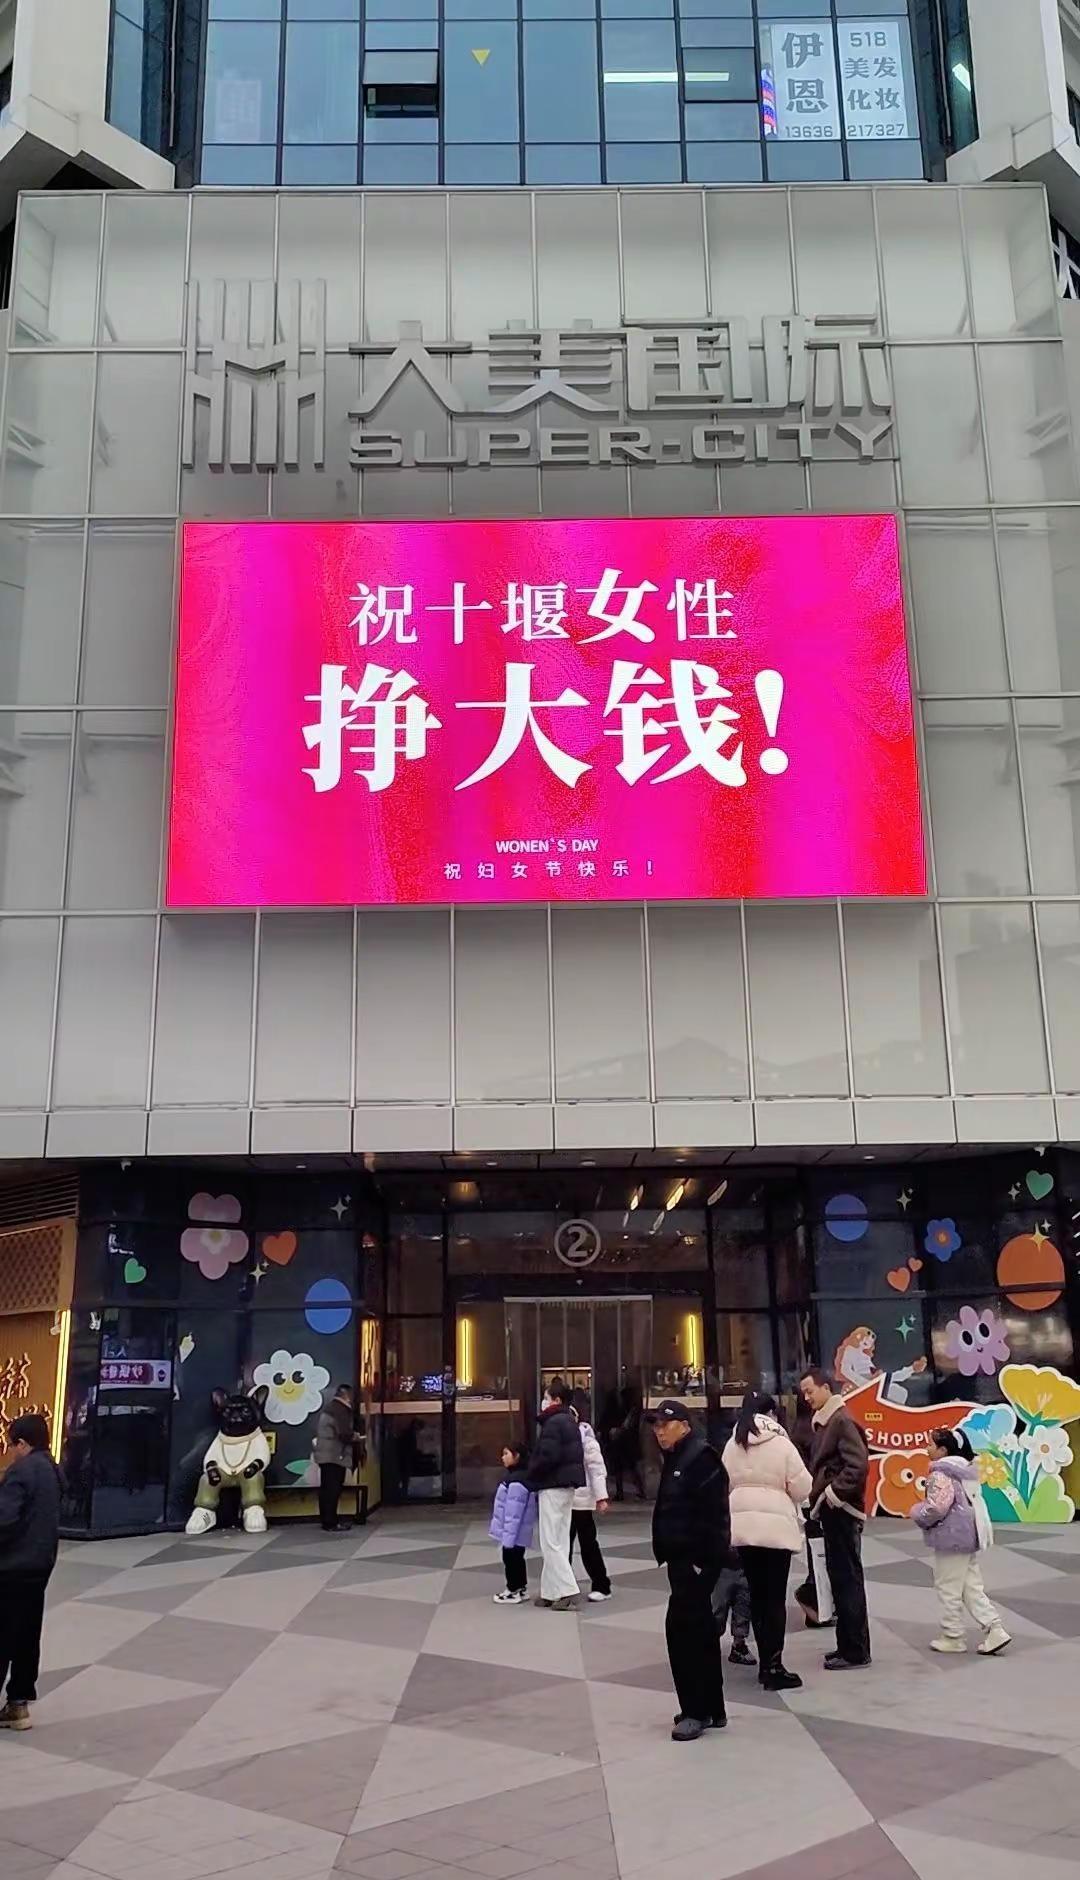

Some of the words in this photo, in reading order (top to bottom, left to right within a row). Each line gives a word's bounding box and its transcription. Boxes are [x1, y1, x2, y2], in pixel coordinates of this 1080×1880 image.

[850, 31, 887, 48] 518
[781, 32, 829, 114] 伊恩
[844, 56, 897, 79] 美发
[847, 87, 900, 111] 化妆
[785, 125, 833, 138] 13636
[847, 123, 904, 137] 217327
[348, 315, 891, 416] 大美国际
[348, 567, 738, 646] 祝十堰女性
[572, 839, 599, 852] DAY
[865, 1424, 949, 1447] SHOPPI
